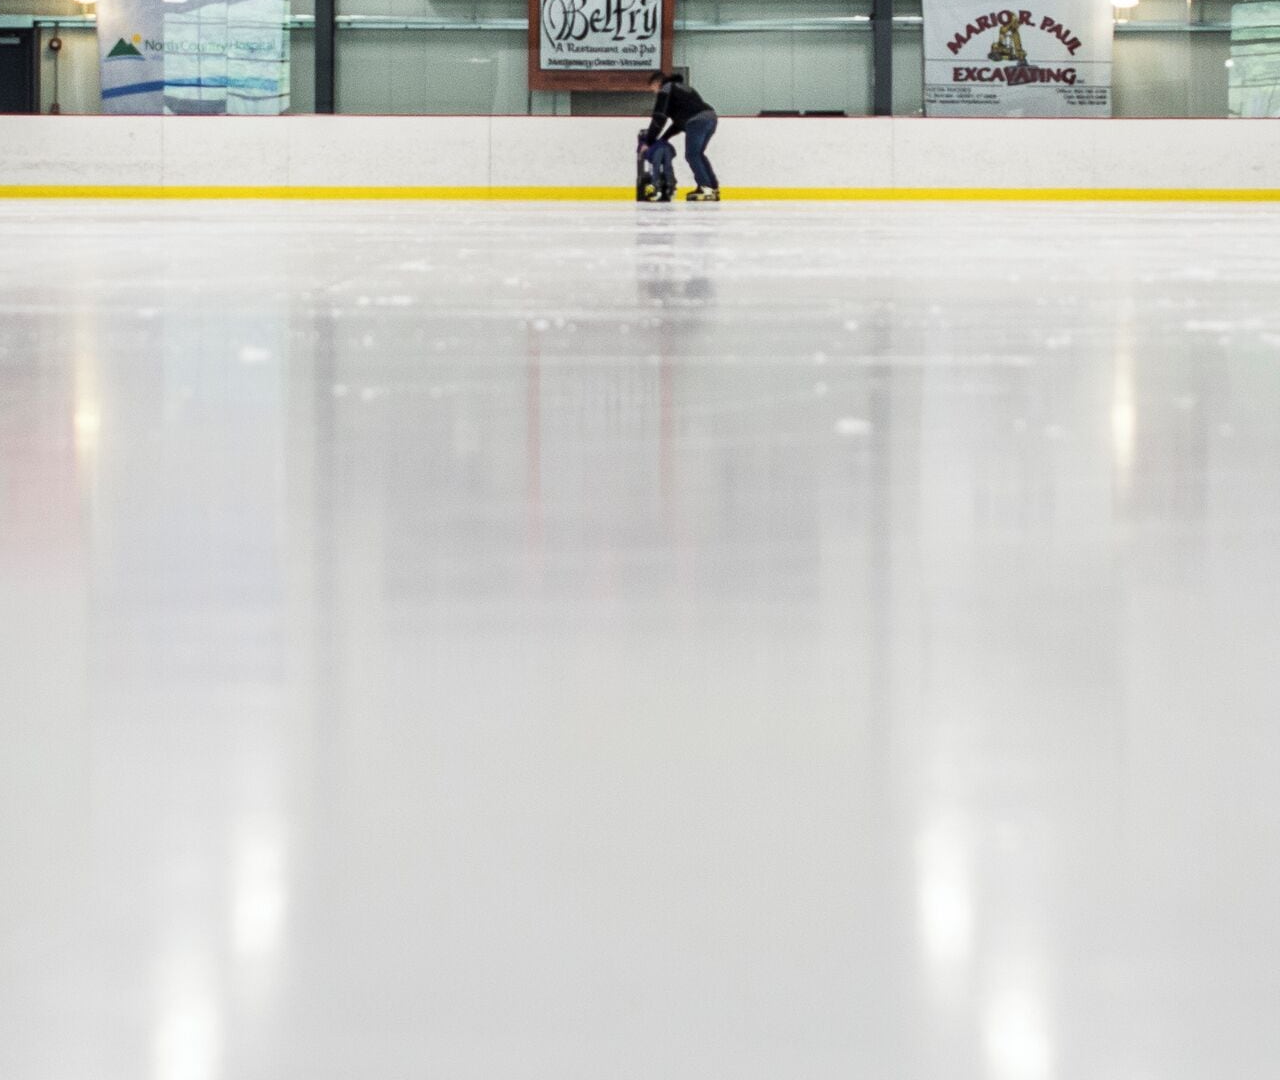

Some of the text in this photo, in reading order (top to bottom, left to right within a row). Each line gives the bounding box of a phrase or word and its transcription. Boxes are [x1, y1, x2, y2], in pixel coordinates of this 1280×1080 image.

[947, 10, 1082, 56] MARIO R. PAUL
[567, 42, 619, 53] Restaurant
[622, 43, 638, 53] and
[953, 67, 1077, 85] EXCAVATING
